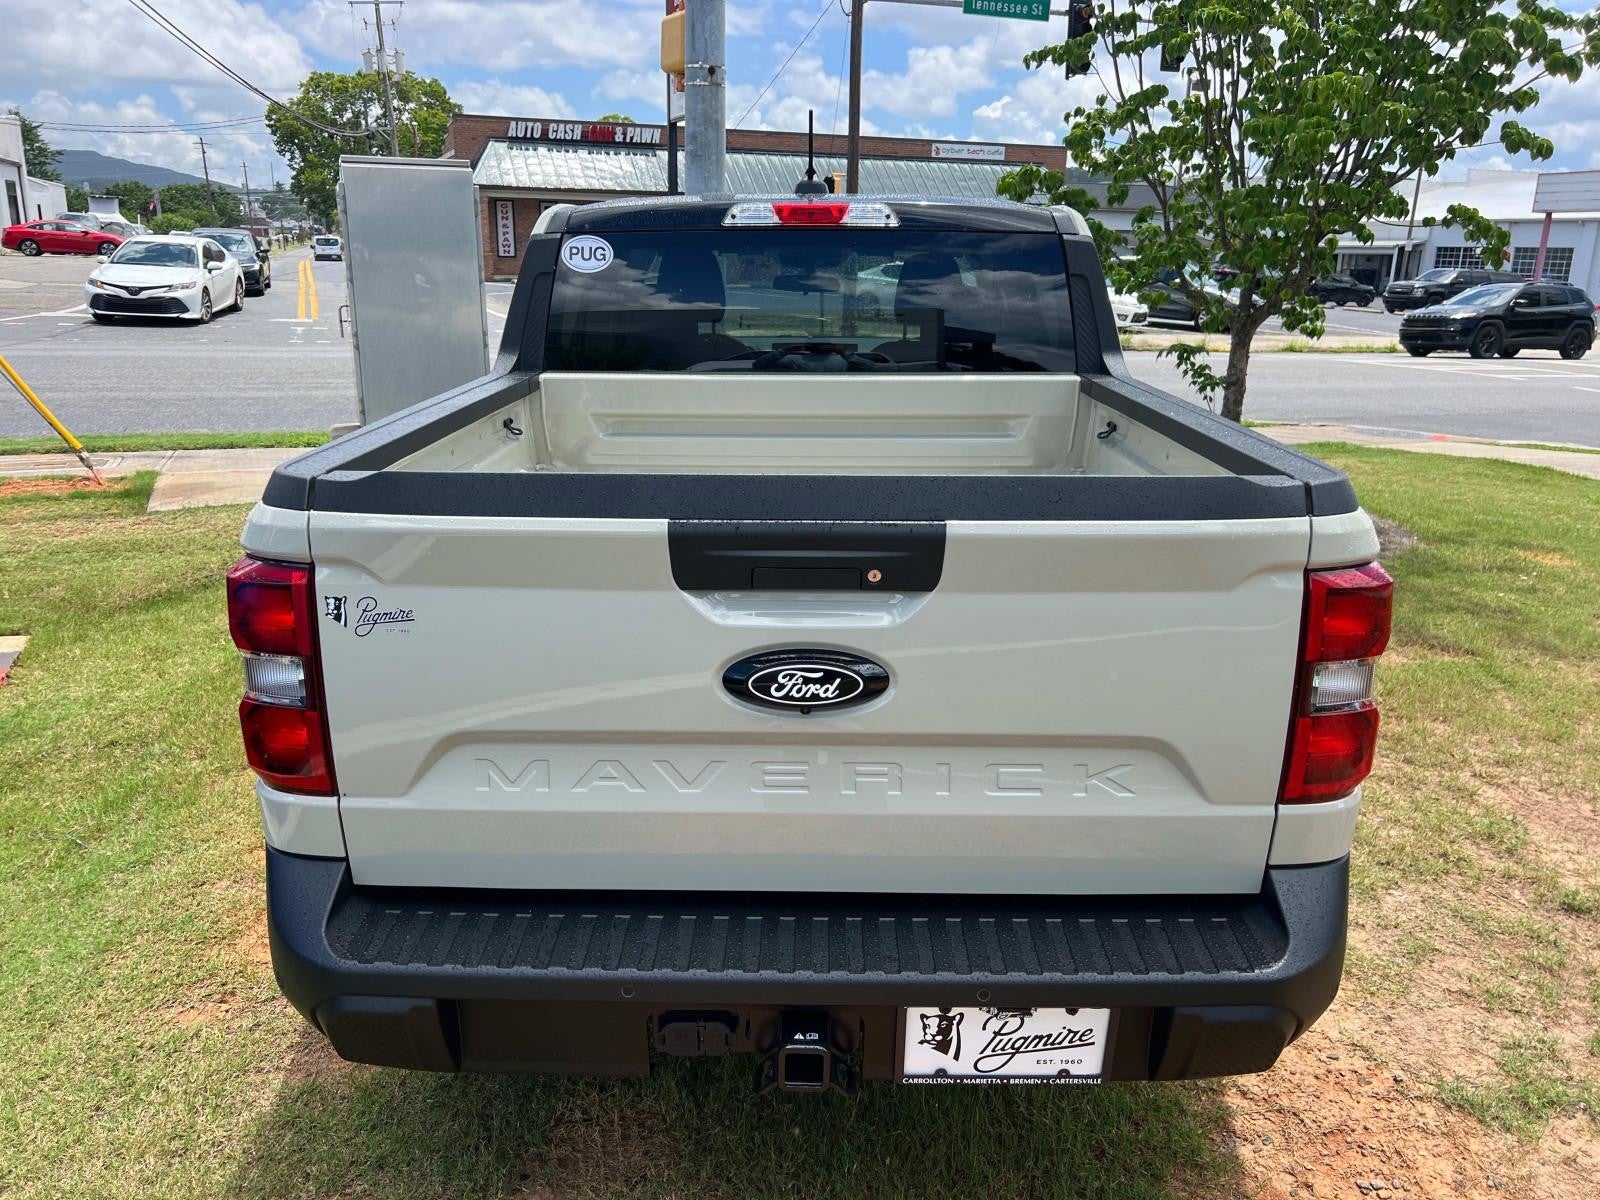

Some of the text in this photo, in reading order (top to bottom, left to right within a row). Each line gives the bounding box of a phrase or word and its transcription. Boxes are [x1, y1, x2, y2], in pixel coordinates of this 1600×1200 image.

[972, 0, 1042, 15] Tennessee St
[508, 120, 542, 138] AUTO
[548, 122, 582, 140] CASH
[615, 126, 624, 142] &
[626, 127, 661, 144] PAWN
[941, 146, 965, 155] cyber
[500, 202, 509, 221] GUN
[502, 230, 511, 255] PAWN
[569, 246, 606, 261] PUG
[355, 596, 415, 637] Pugmire
[770, 670, 841, 698] Ford
[474, 758, 1136, 797] MAVERICK
[973, 1013, 1096, 1073] Pugmire
